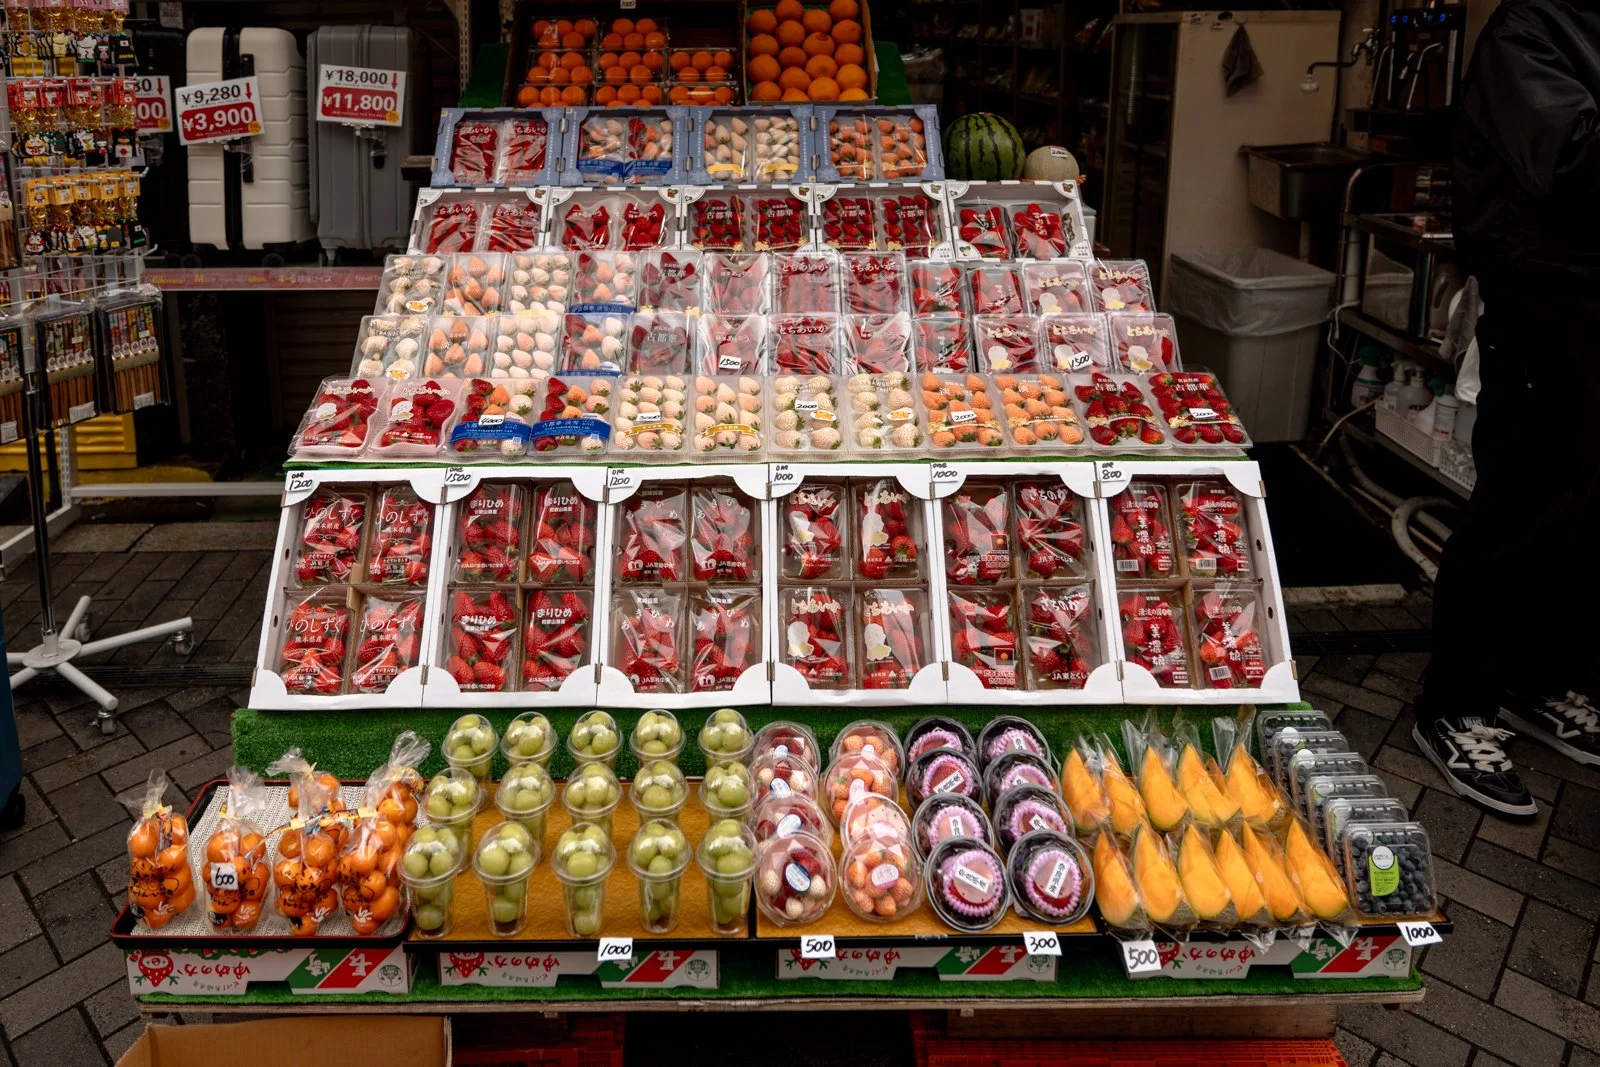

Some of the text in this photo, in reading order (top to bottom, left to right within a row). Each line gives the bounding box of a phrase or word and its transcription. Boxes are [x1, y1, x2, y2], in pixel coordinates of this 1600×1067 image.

[325, 69, 388, 85] ¥18,000
[182, 84, 241, 106] ¥9,280
[324, 92, 395, 112] ¥11,800
[183, 106, 254, 133] ¥3,900
[719, 358, 741, 368] 1500
[1070, 354, 1090, 369] 1500
[1175, 383, 1210, 392] 古都華
[446, 473, 471, 482] 1500
[774, 473, 794, 482] 1000
[933, 471, 958, 479] 1000
[1102, 469, 1122, 479] 800
[289, 479, 313, 490] 1200
[609, 477, 630, 487] 1200
[469, 499, 504, 509] まりひめ
[535, 607, 573, 618] まりひめ
[285, 617, 340, 633] ひのしずく
[359, 616, 416, 632] ひのしずく
[460, 615, 497, 625] まりひめ
[1051, 672, 1088, 680] JA東とくし
[1461, 716, 1484, 728] VANS
[214, 866, 235, 885] 600
[1048, 862, 1066, 894] 奈良県産
[1407, 926, 1435, 942] 1000
[600, 943, 631, 956] 1000
[805, 939, 833, 953] 500
[1029, 937, 1057, 952] 300
[1128, 949, 1157, 969] 500
